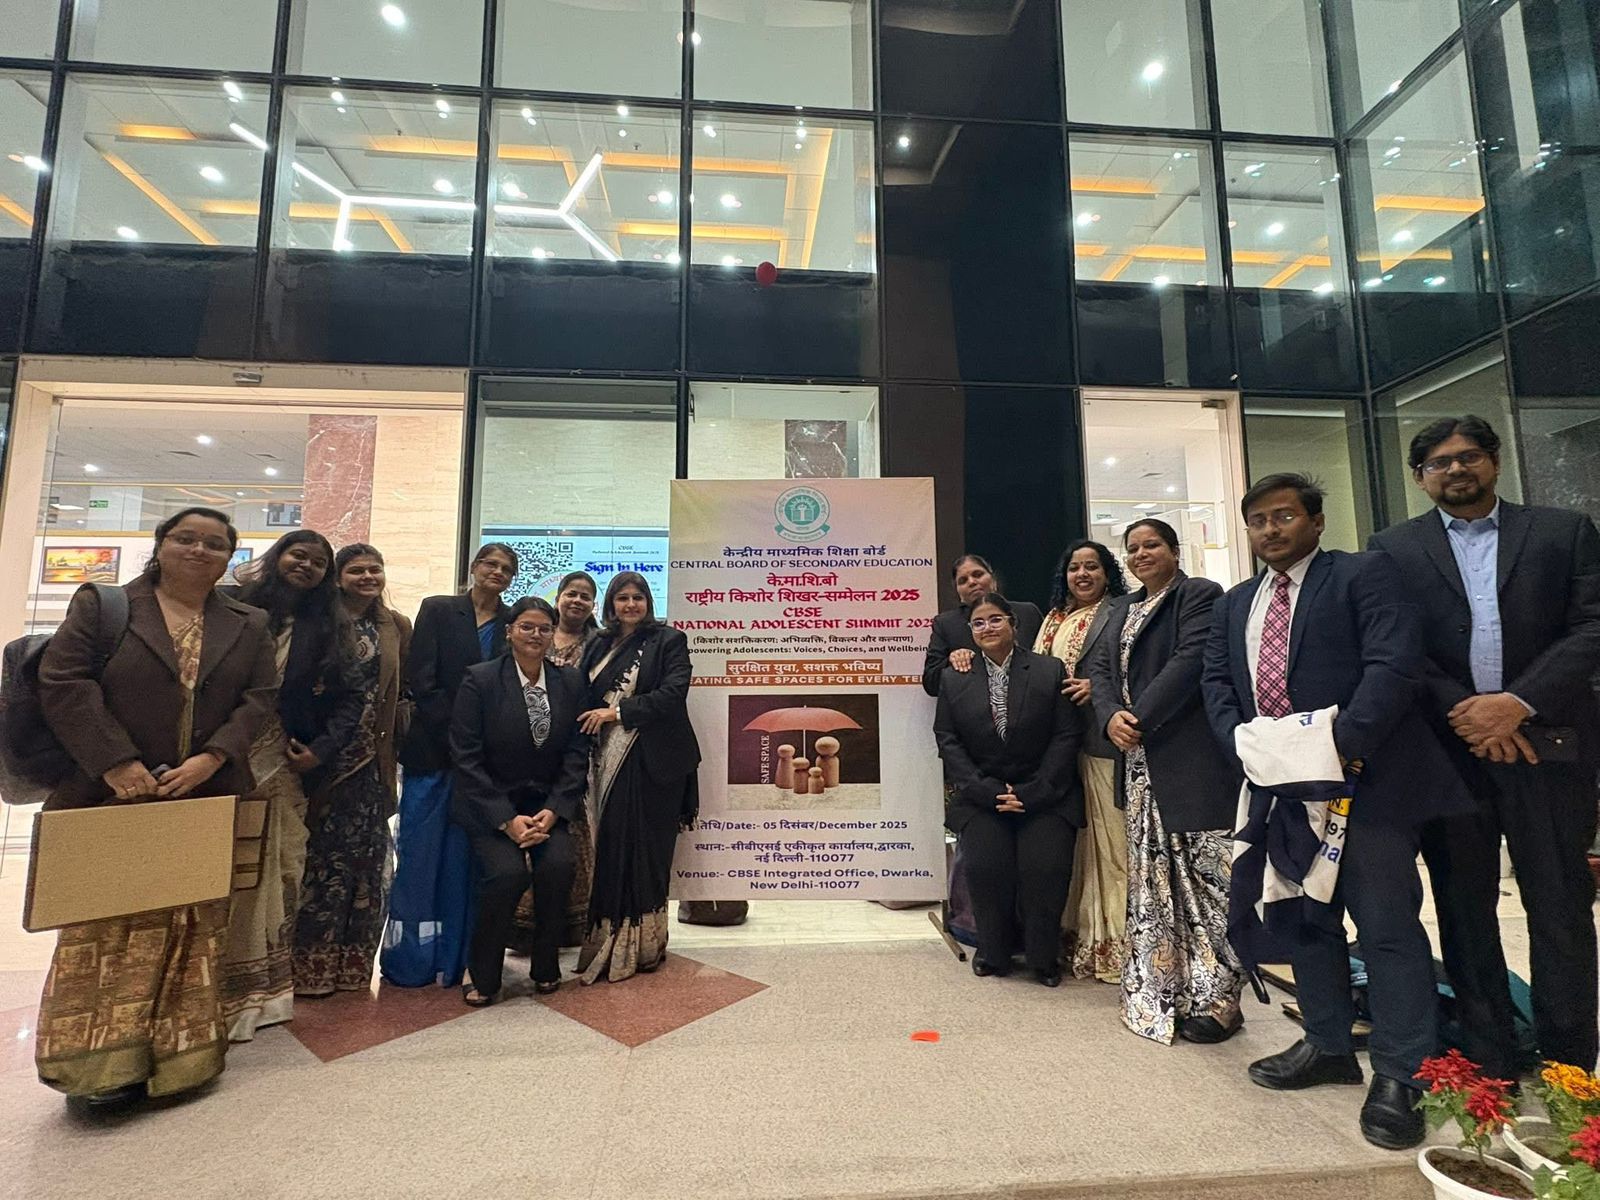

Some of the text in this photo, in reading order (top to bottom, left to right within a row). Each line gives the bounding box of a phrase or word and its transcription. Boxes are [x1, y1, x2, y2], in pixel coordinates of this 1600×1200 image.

[723, 545, 886, 557] केन्द्रीय माध्यमिक शिक्षा बोर्ड
[584, 561, 663, 574] Sign In Here
[671, 558, 933, 568] CENTRAL BOARD OF SECONDARY EDUCATION
[685, 589, 725, 606] राष्ट्रीय
[729, 588, 774, 602] किशोर
[881, 589, 920, 601] 2025
[783, 607, 822, 617] CBSE
[673, 620, 746, 630] NATIONAL
[750, 619, 842, 630] ADOLESCENT
[846, 619, 902, 628] SUMMIT
[733, 646, 791, 654] Adolescents:
[828, 645, 867, 653] Choices,
[888, 644, 928, 652] Wellbein
[728, 660, 881, 674] सुरक्षित युवा, सशक्त भविष्य
[737, 676, 769, 684] SAFE
[775, 676, 824, 684] SPACES
[858, 675, 898, 683] EVERY
[761, 735, 770, 784] SAFE SPACE
[763, 822, 777, 830] 05
[780, 820, 877, 831] दिसंबर/December
[880, 821, 908, 829] 2025
[784, 841, 825, 852] एकीकृत
[755, 852, 854, 863] नई दिल्ली-110077
[677, 868, 934, 879] Venue:- CBSE Integrated Office, Dwarka,
[781, 880, 860, 889] Delhi-110077
